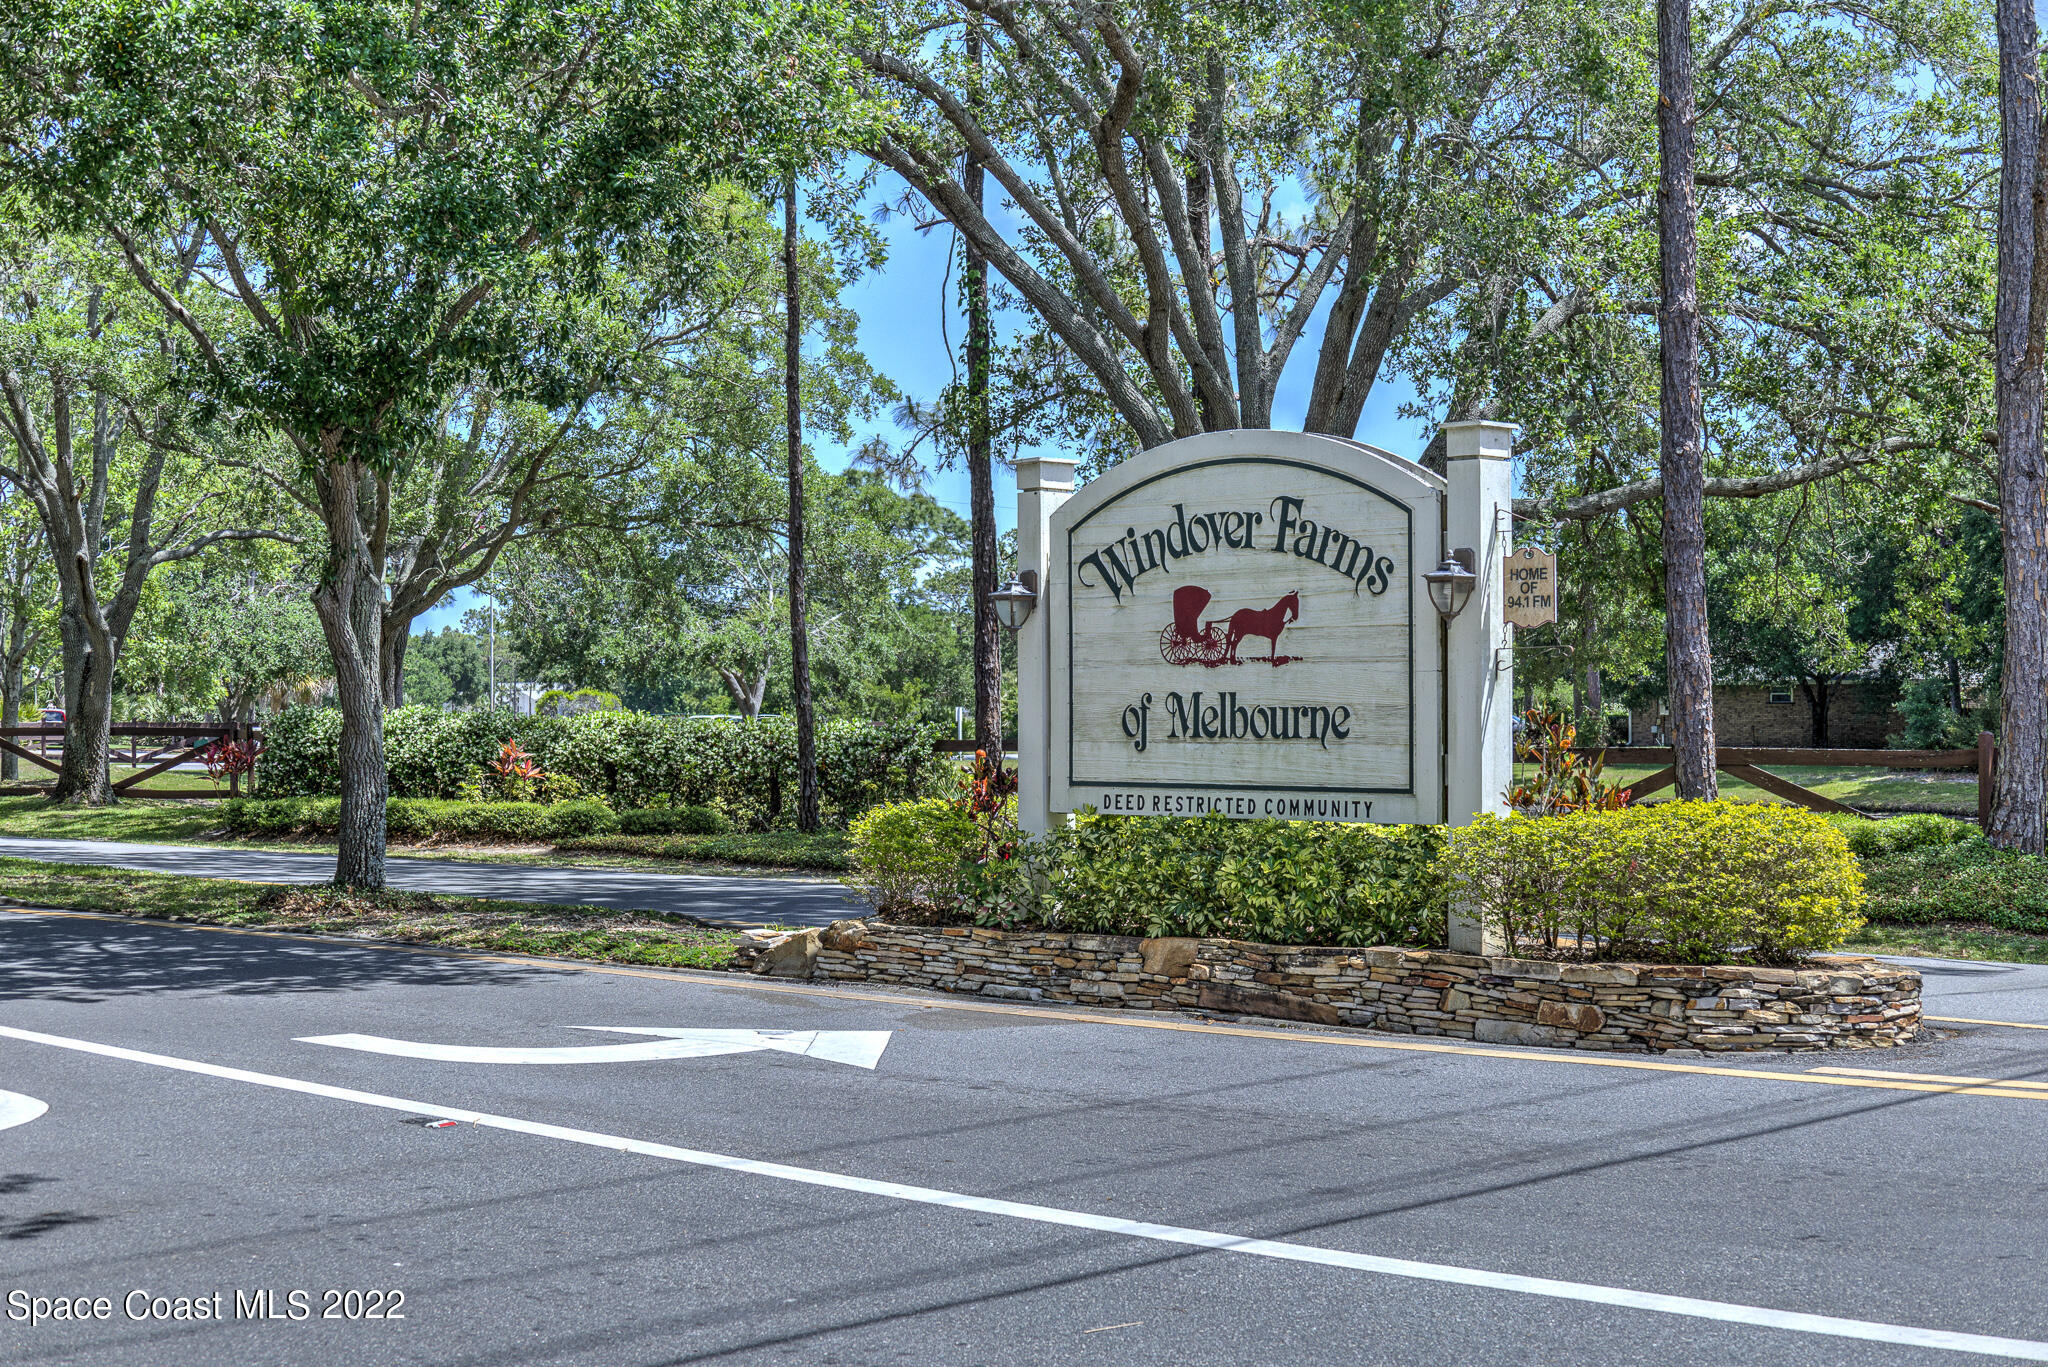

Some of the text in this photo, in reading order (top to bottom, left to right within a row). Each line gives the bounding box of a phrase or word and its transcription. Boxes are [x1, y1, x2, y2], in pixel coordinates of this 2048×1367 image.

[1077, 495, 1395, 605] Windover Farms
[1510, 568, 1548, 580] HOME
[1520, 582, 1538, 594] OF
[1507, 595, 1551, 608] 94.1 FM
[1121, 691, 1351, 752] of Melbourne
[1103, 793, 1374, 819] DEED RESTRICTED COMMUNITY
